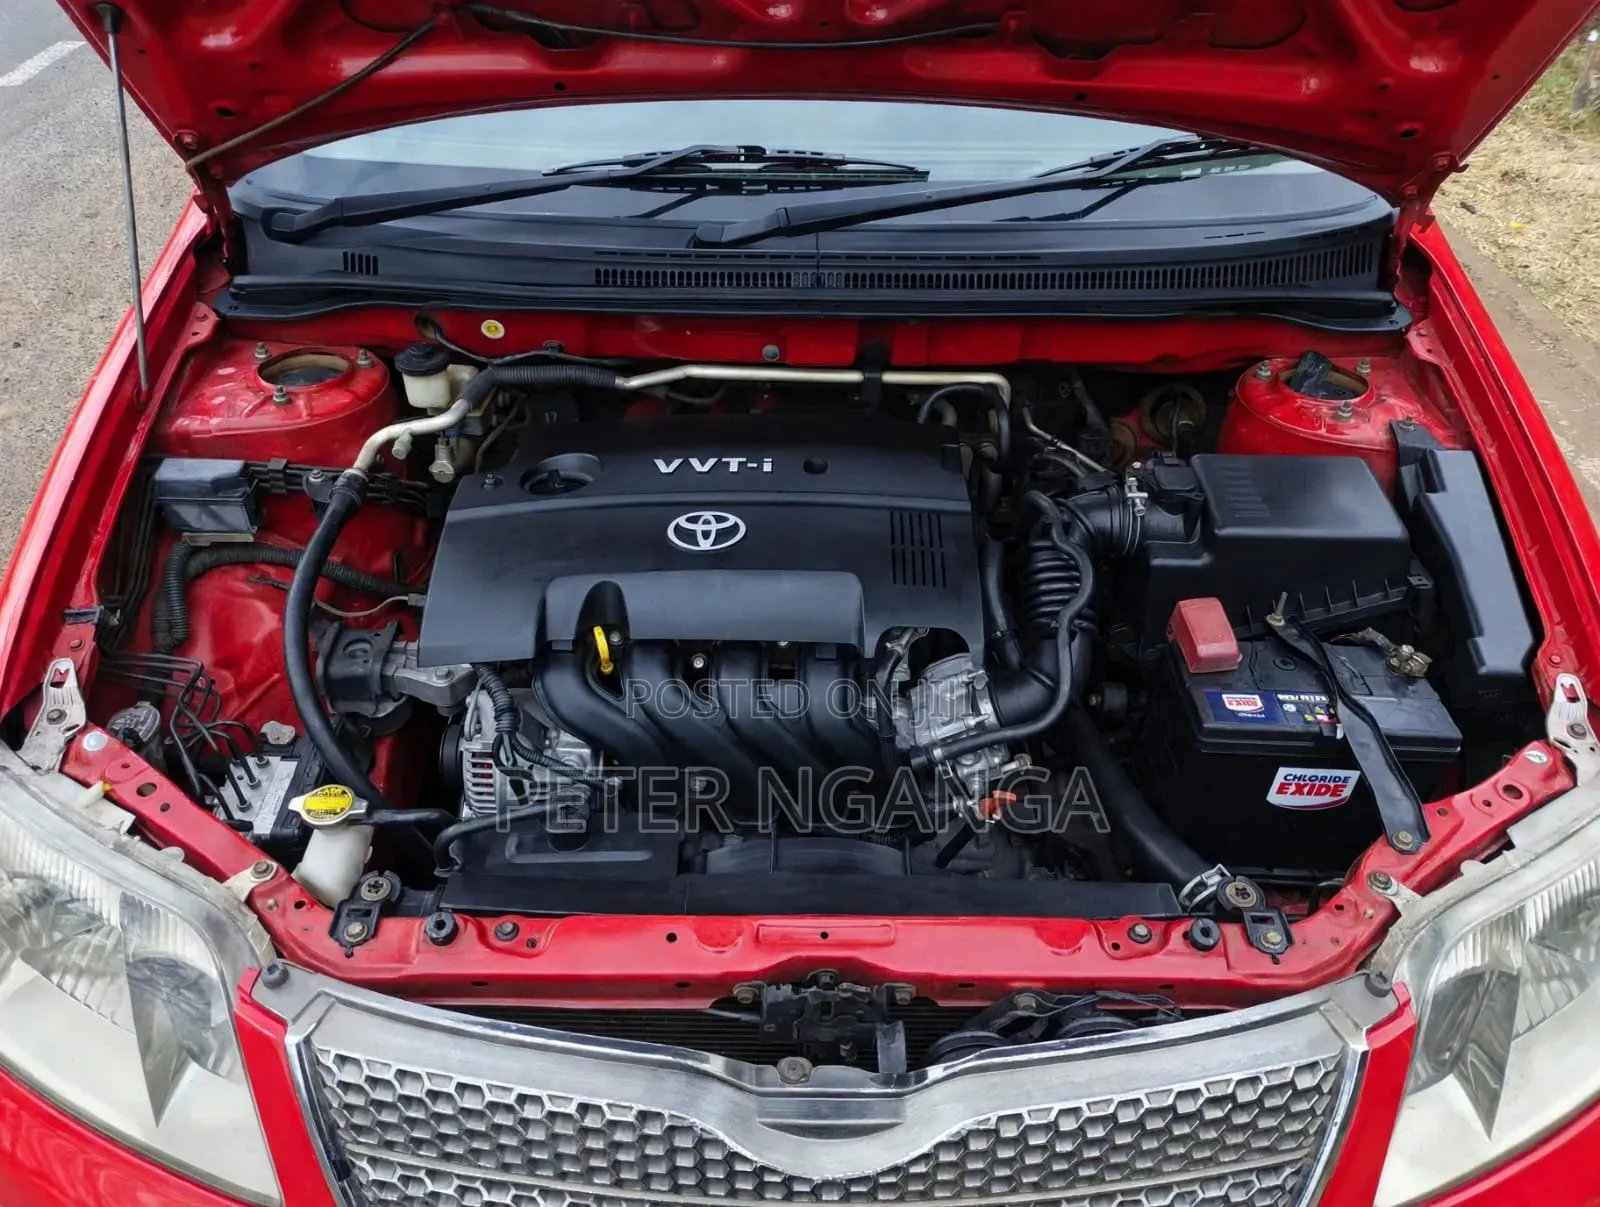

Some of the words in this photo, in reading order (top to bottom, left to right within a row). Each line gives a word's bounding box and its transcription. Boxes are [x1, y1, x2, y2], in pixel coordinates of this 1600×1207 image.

[653, 457, 773, 473] VVT-i
[1283, 773, 1352, 784] CHLORIDE
[1275, 782, 1348, 797] EXIDE
